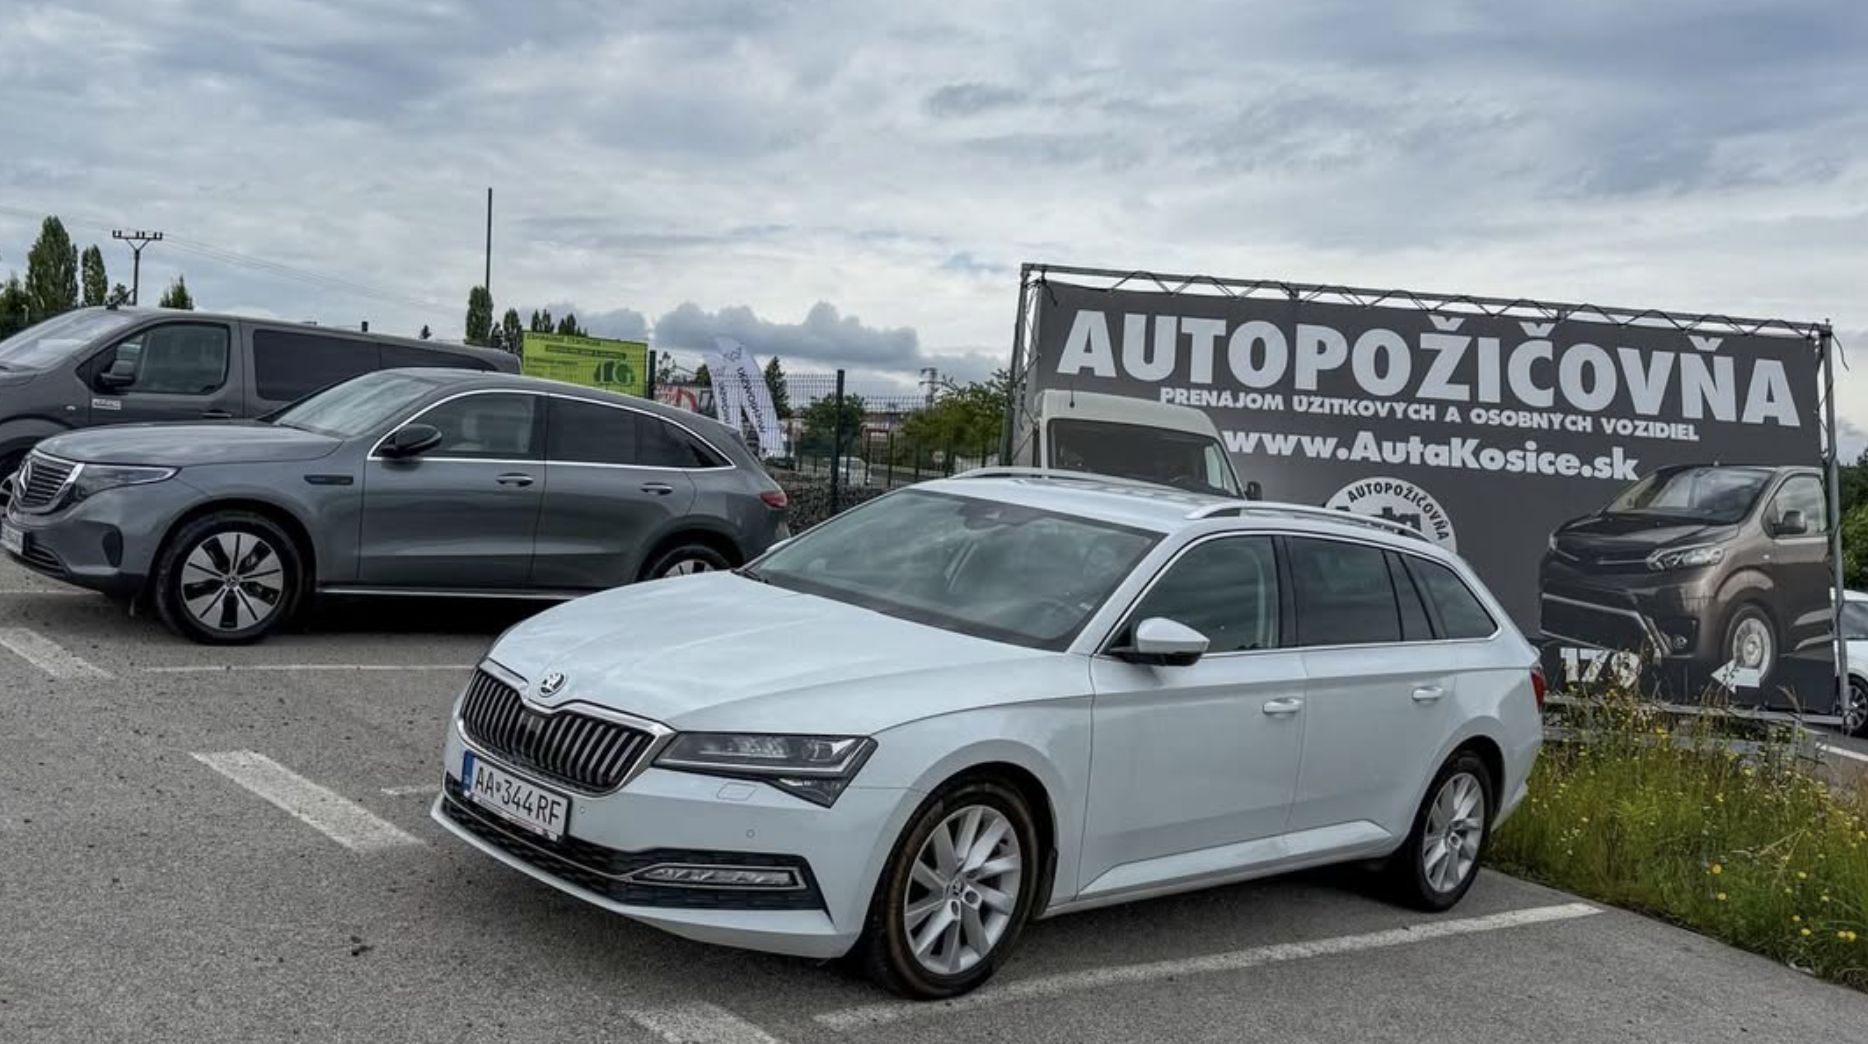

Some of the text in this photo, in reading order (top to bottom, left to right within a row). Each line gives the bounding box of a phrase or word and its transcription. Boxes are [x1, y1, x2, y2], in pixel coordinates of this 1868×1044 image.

[1056, 309, 1800, 427] AUTOPOŽIČOVŇA
[1444, 405, 1462, 423] A
[1601, 416, 1700, 441] VOZIDIEL
[1222, 430, 1639, 482] www.AutaKosice.sk
[1347, 481, 1450, 541] AUTOPOŽIČOVŇA
